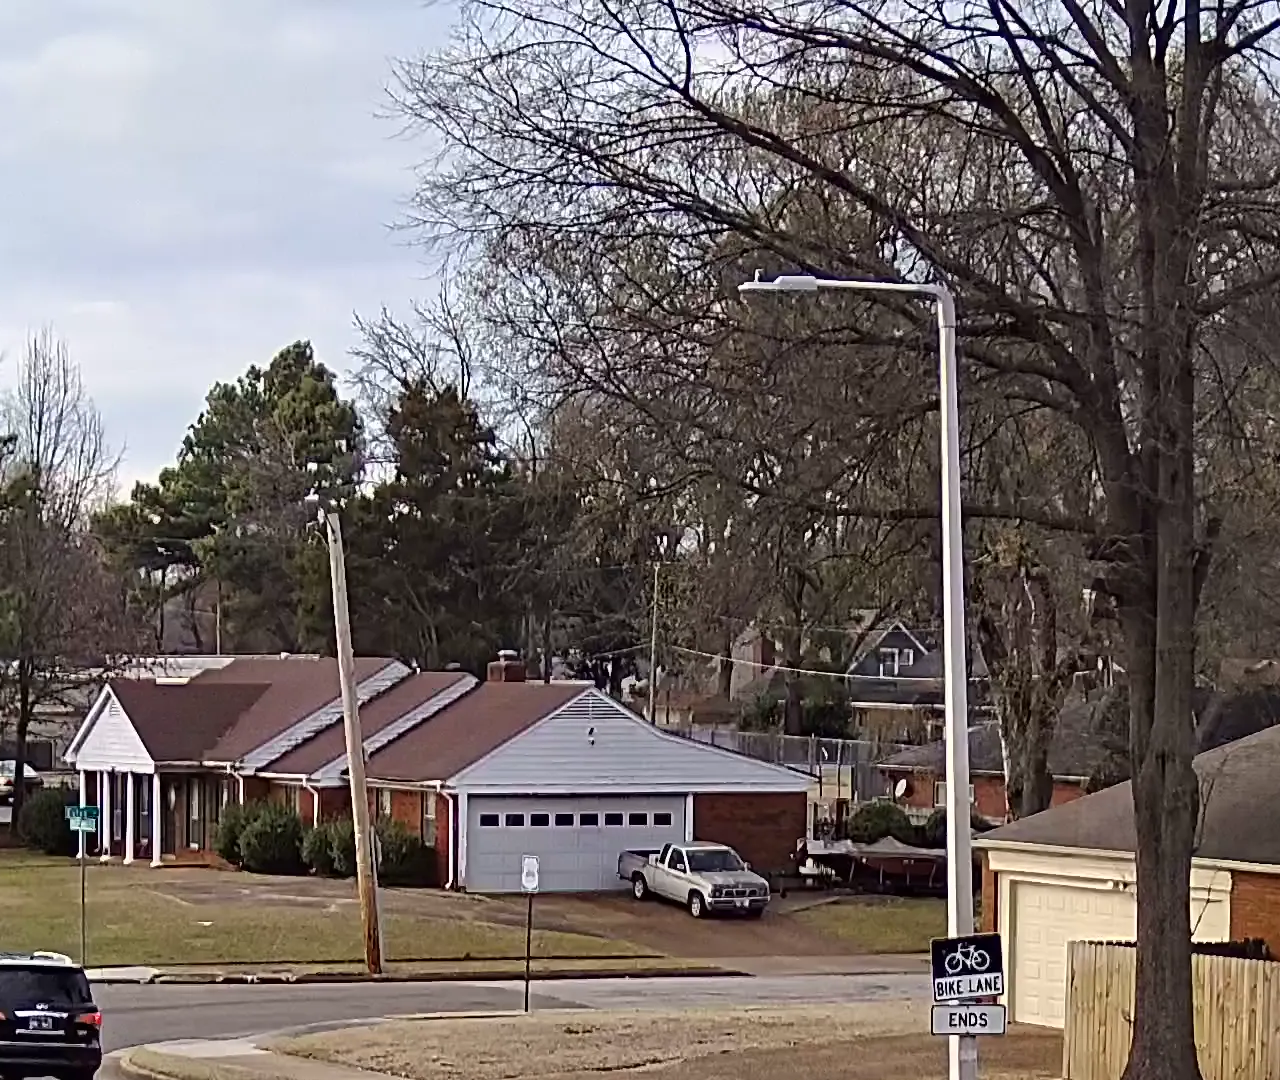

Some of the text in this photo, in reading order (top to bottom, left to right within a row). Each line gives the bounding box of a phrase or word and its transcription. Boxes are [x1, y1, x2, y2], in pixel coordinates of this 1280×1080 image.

[936, 975, 1001, 997] BIKE LANE
[948, 1012, 988, 1028] ENDS
